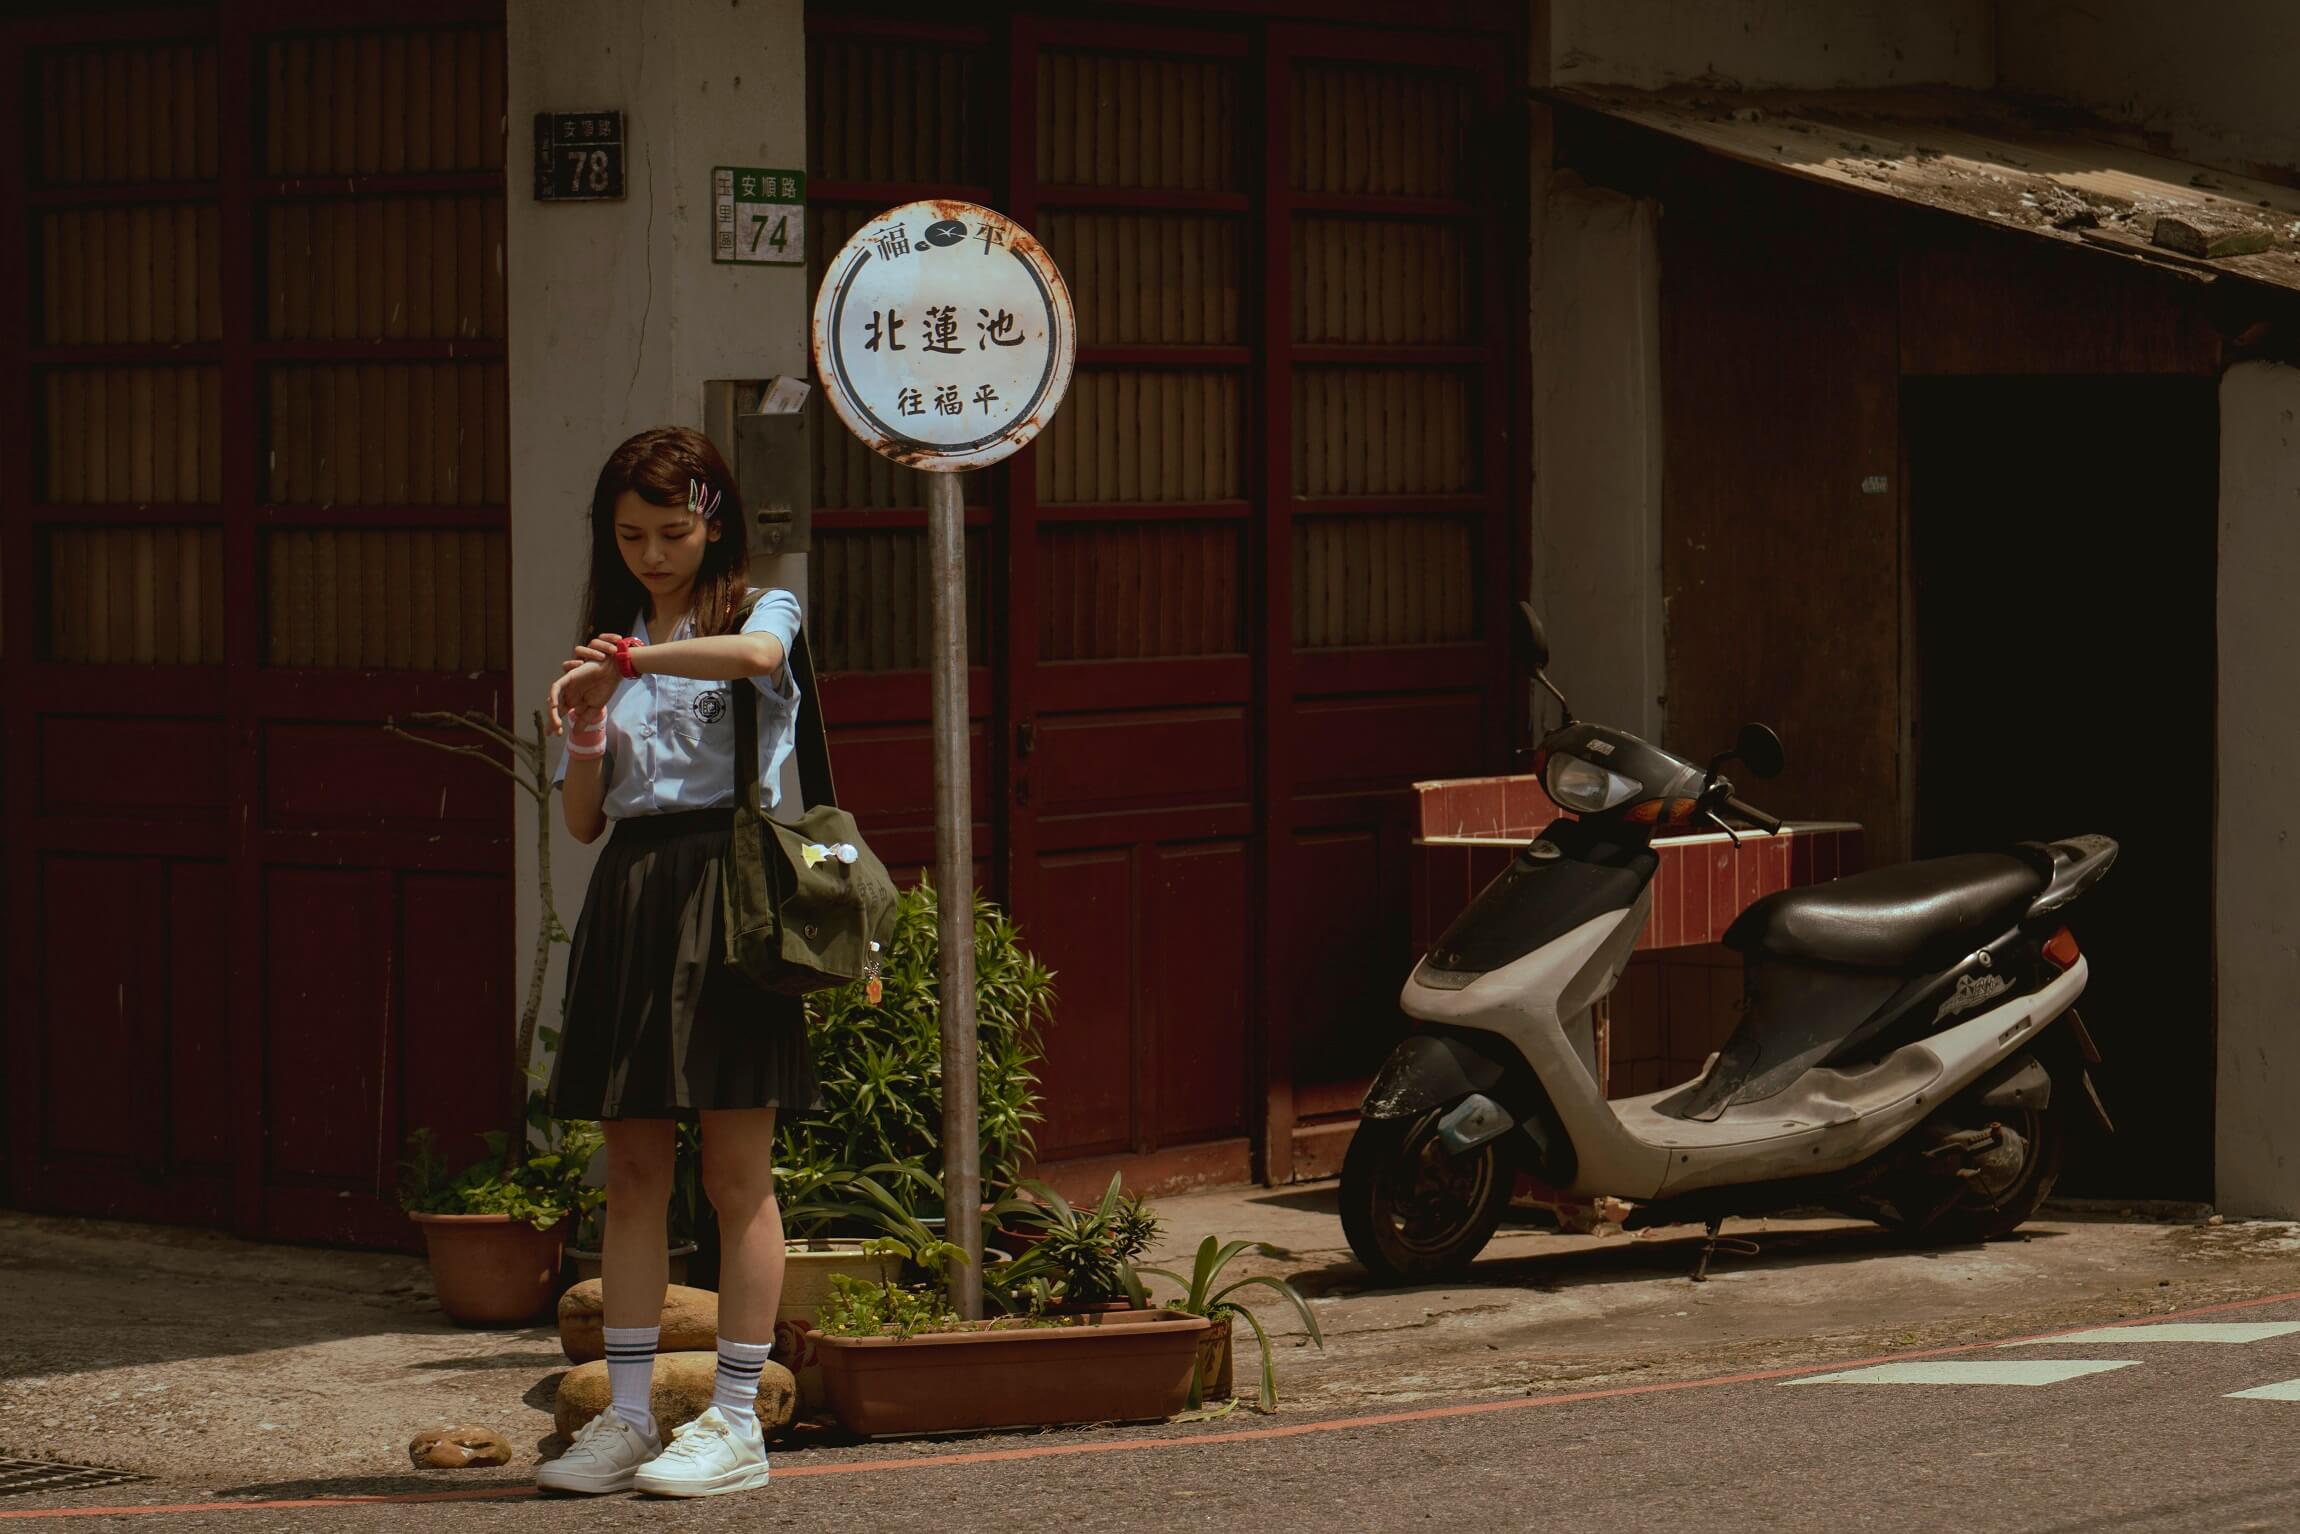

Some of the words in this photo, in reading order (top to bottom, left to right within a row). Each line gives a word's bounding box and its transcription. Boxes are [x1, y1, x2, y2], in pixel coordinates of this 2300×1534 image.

[563, 120, 611, 138] 安順路
[567, 150, 609, 192] 78
[741, 174, 797, 199] 安順路
[751, 214, 788, 253] 74
[864, 305, 1026, 355] 北蓮池
[897, 383, 1000, 417] 往福平
